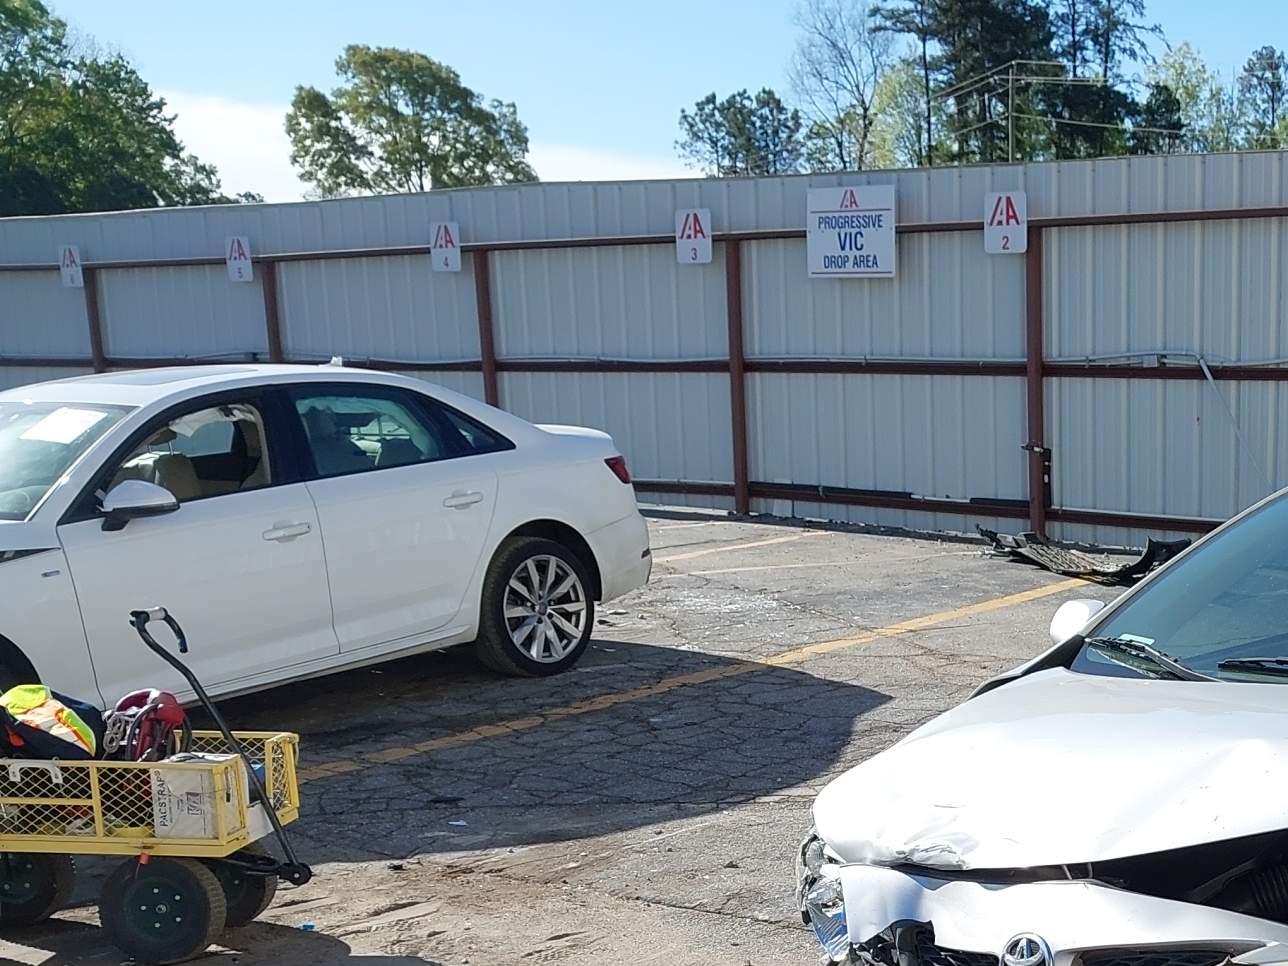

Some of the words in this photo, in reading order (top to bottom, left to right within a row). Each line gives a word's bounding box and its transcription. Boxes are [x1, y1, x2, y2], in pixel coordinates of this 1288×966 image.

[817, 213, 884, 230] PROGRESSIVE
[836, 231, 865, 252] VIC
[1001, 235, 1010, 251] 2
[690, 247, 698, 261] 3
[823, 254, 850, 270] DROP
[852, 253, 879, 269] AREA
